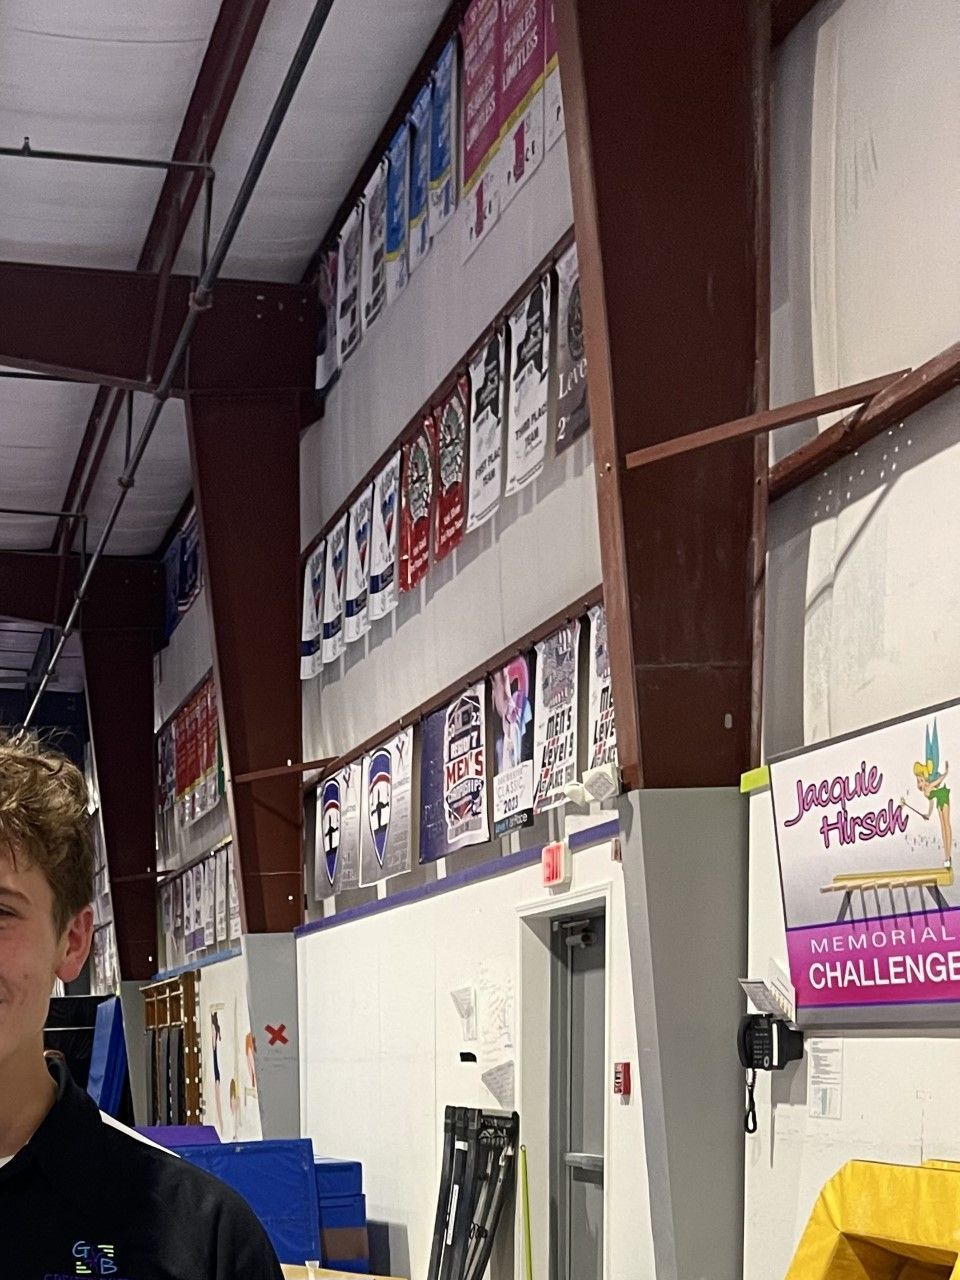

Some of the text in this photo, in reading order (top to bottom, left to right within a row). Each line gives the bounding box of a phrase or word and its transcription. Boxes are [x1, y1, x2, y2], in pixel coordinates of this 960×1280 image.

[558, 358, 588, 400] Leve
[530, 403, 548, 425] PLAC
[445, 750, 484, 791] MEN'S
[784, 761, 883, 827] Jacquie
[820, 799, 909, 849] Hirsch
[810, 926, 956, 954] MEMORIAL
[809, 950, 960, 990] CHALLENGE
